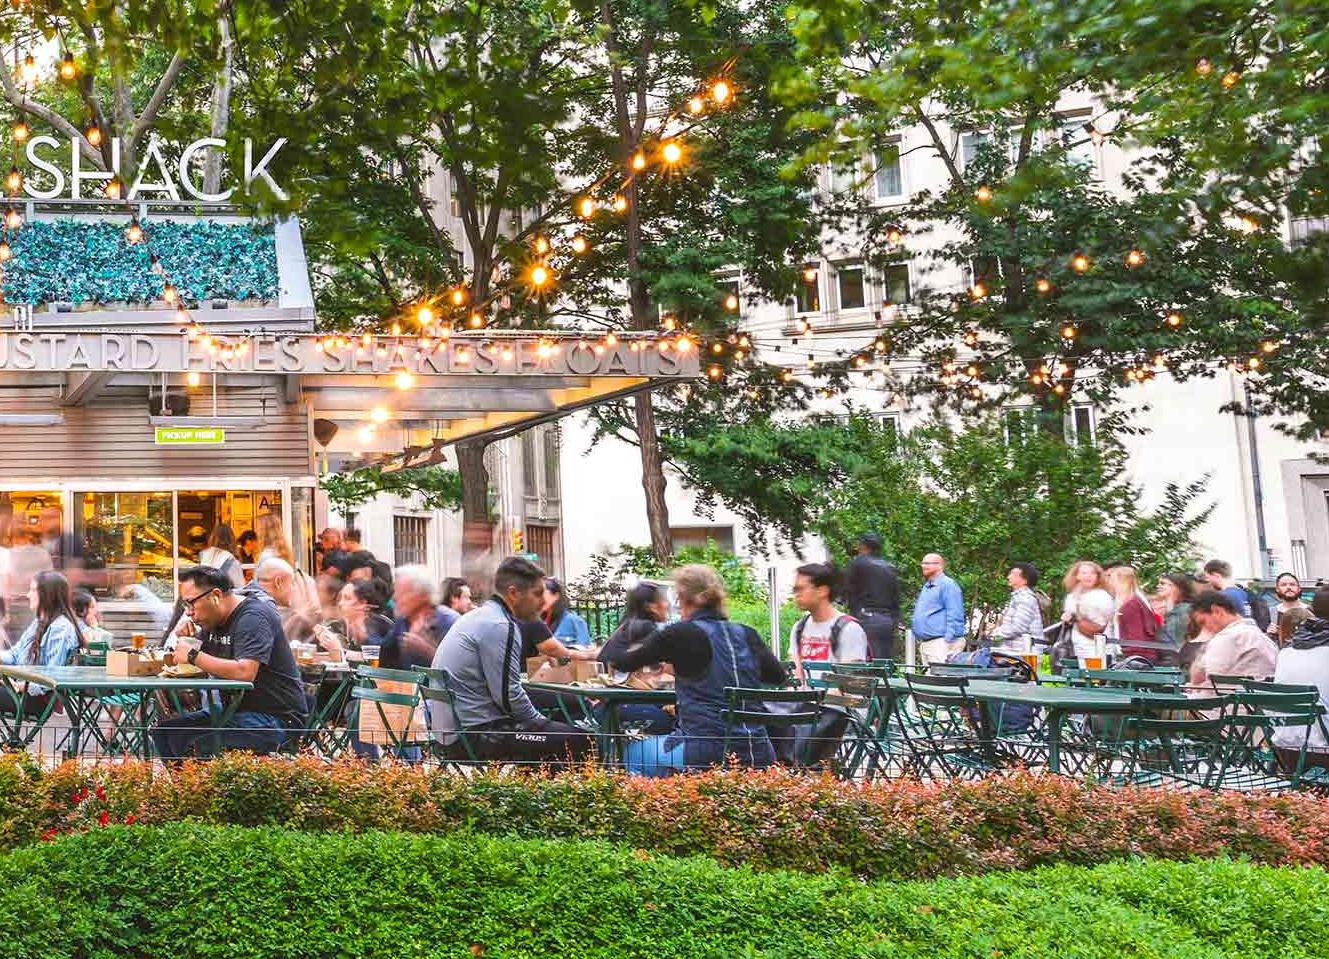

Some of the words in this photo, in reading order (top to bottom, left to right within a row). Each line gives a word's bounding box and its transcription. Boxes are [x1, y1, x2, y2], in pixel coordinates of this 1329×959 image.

[22, 135, 291, 201] SHACK
[182, 333, 304, 373] FRIES
[322, 335, 500, 375] SHAKES
